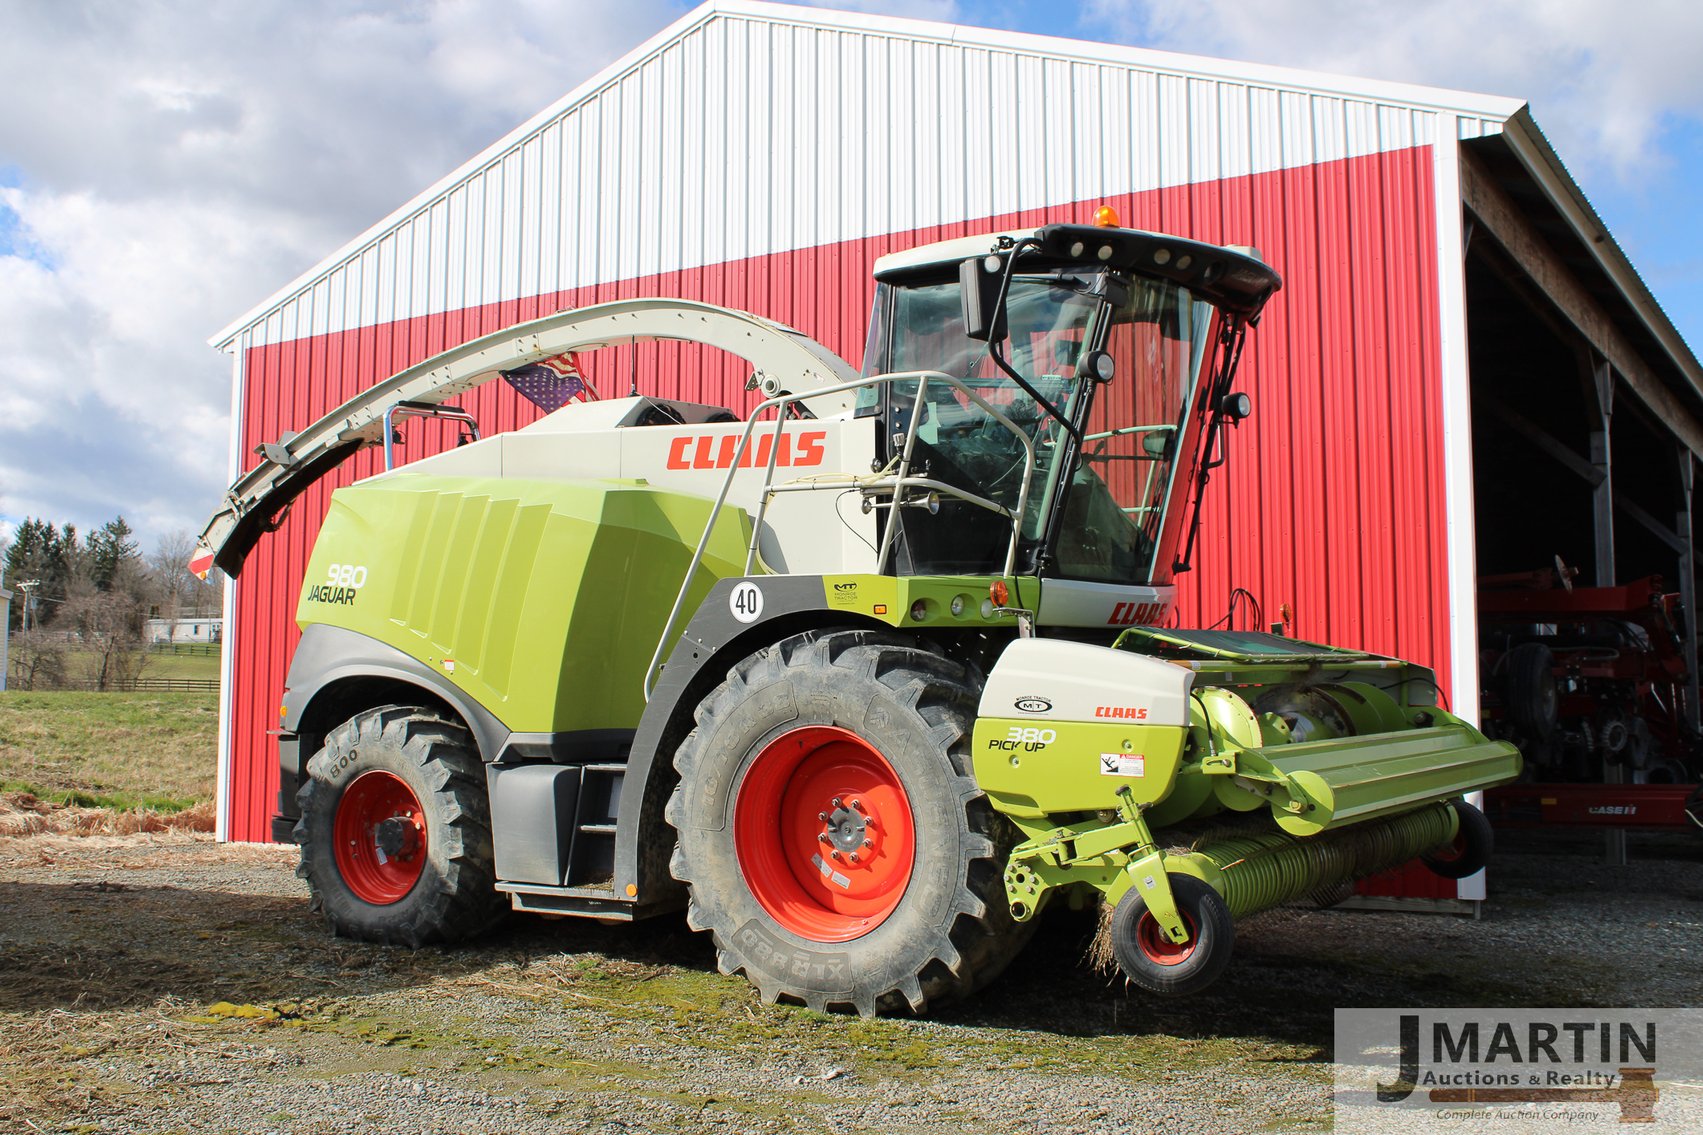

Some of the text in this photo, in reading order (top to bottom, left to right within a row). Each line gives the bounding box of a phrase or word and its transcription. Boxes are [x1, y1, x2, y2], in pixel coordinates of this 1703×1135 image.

[666, 431, 827, 470] CLAAS
[326, 563, 368, 588] 980
[308, 585, 356, 605] JAGUAR
[735, 588, 757, 614] 40
[1107, 602, 1168, 624] CLAAS
[1095, 706, 1147, 719] CLAAS
[988, 739, 1046, 752] PICK UP
[1006, 726, 1057, 744] 380
[330, 749, 358, 778] 800
[1589, 806, 1624, 815] CASE
